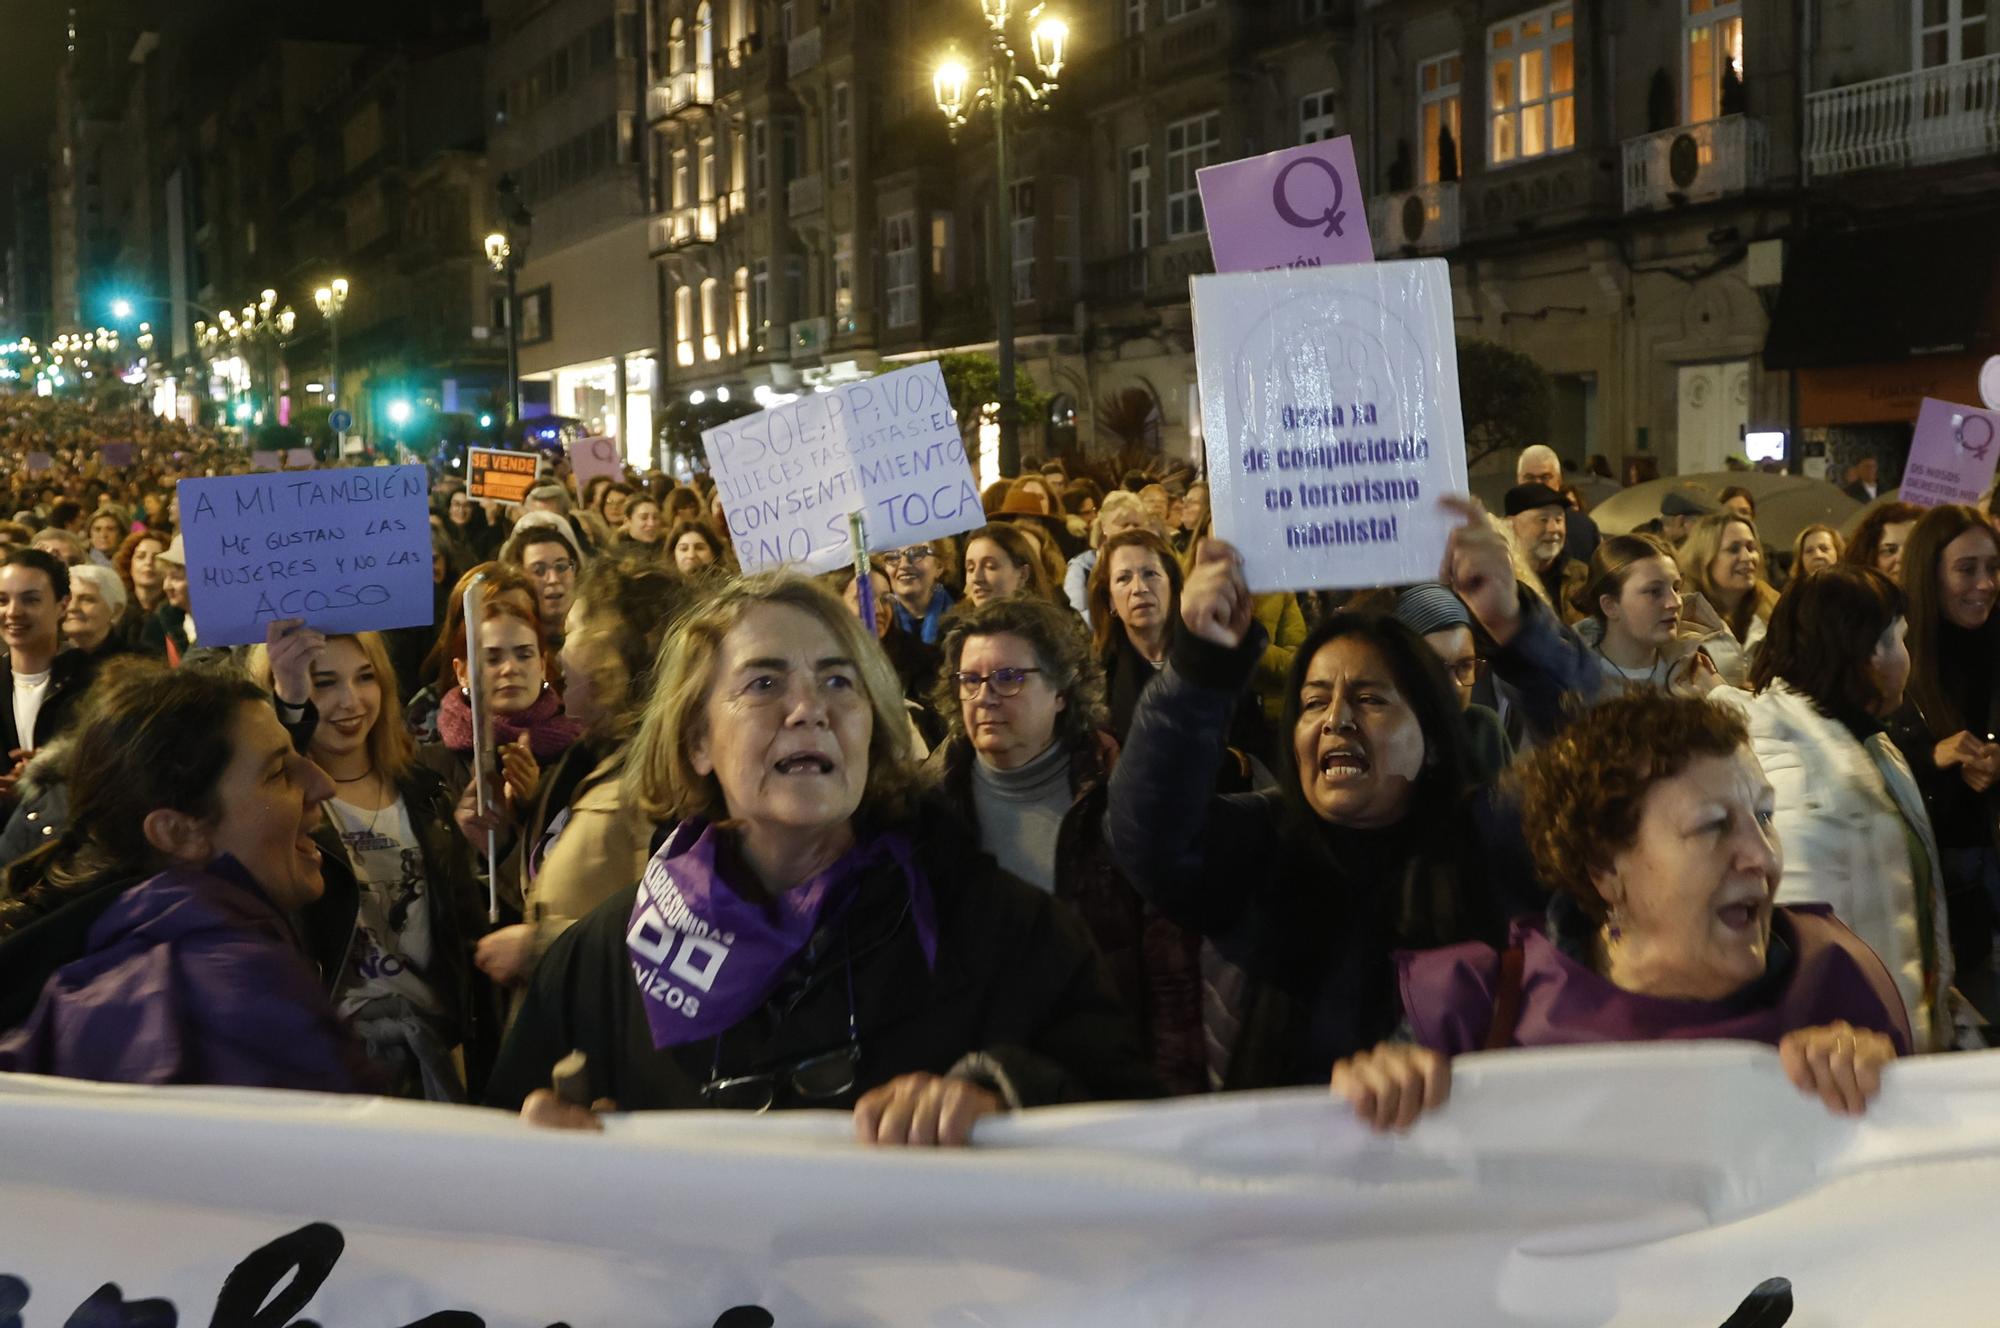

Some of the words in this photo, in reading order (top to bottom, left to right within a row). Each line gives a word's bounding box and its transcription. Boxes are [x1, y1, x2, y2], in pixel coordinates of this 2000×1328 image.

[931, 410, 957, 432] EL
[472, 452, 488, 469] SE
[491, 455, 536, 473] VENDE
[1243, 447, 1270, 473] de
[1277, 436, 1429, 471] complicidade
[1927, 467, 1961, 483] NOSOS
[193, 491, 216, 524] A
[235, 485, 275, 517] MI
[287, 468, 422, 505] TAMBIÉN
[1265, 486, 1294, 512] co
[1299, 477, 1420, 509] terrorismo
[221, 534, 251, 557] ME
[266, 527, 345, 550] GUSTAN
[365, 519, 406, 535] LAS
[760, 527, 811, 568] NO
[878, 480, 983, 534] TOCA
[1286, 515, 1399, 549] machista!
[203, 558, 317, 587] MUJERES
[336, 558, 346, 575] Y
[353, 555, 377, 572] NO
[386, 551, 421, 566] LAS
[253, 584, 391, 624] ACOSO
[632, 961, 700, 1018] vizos
